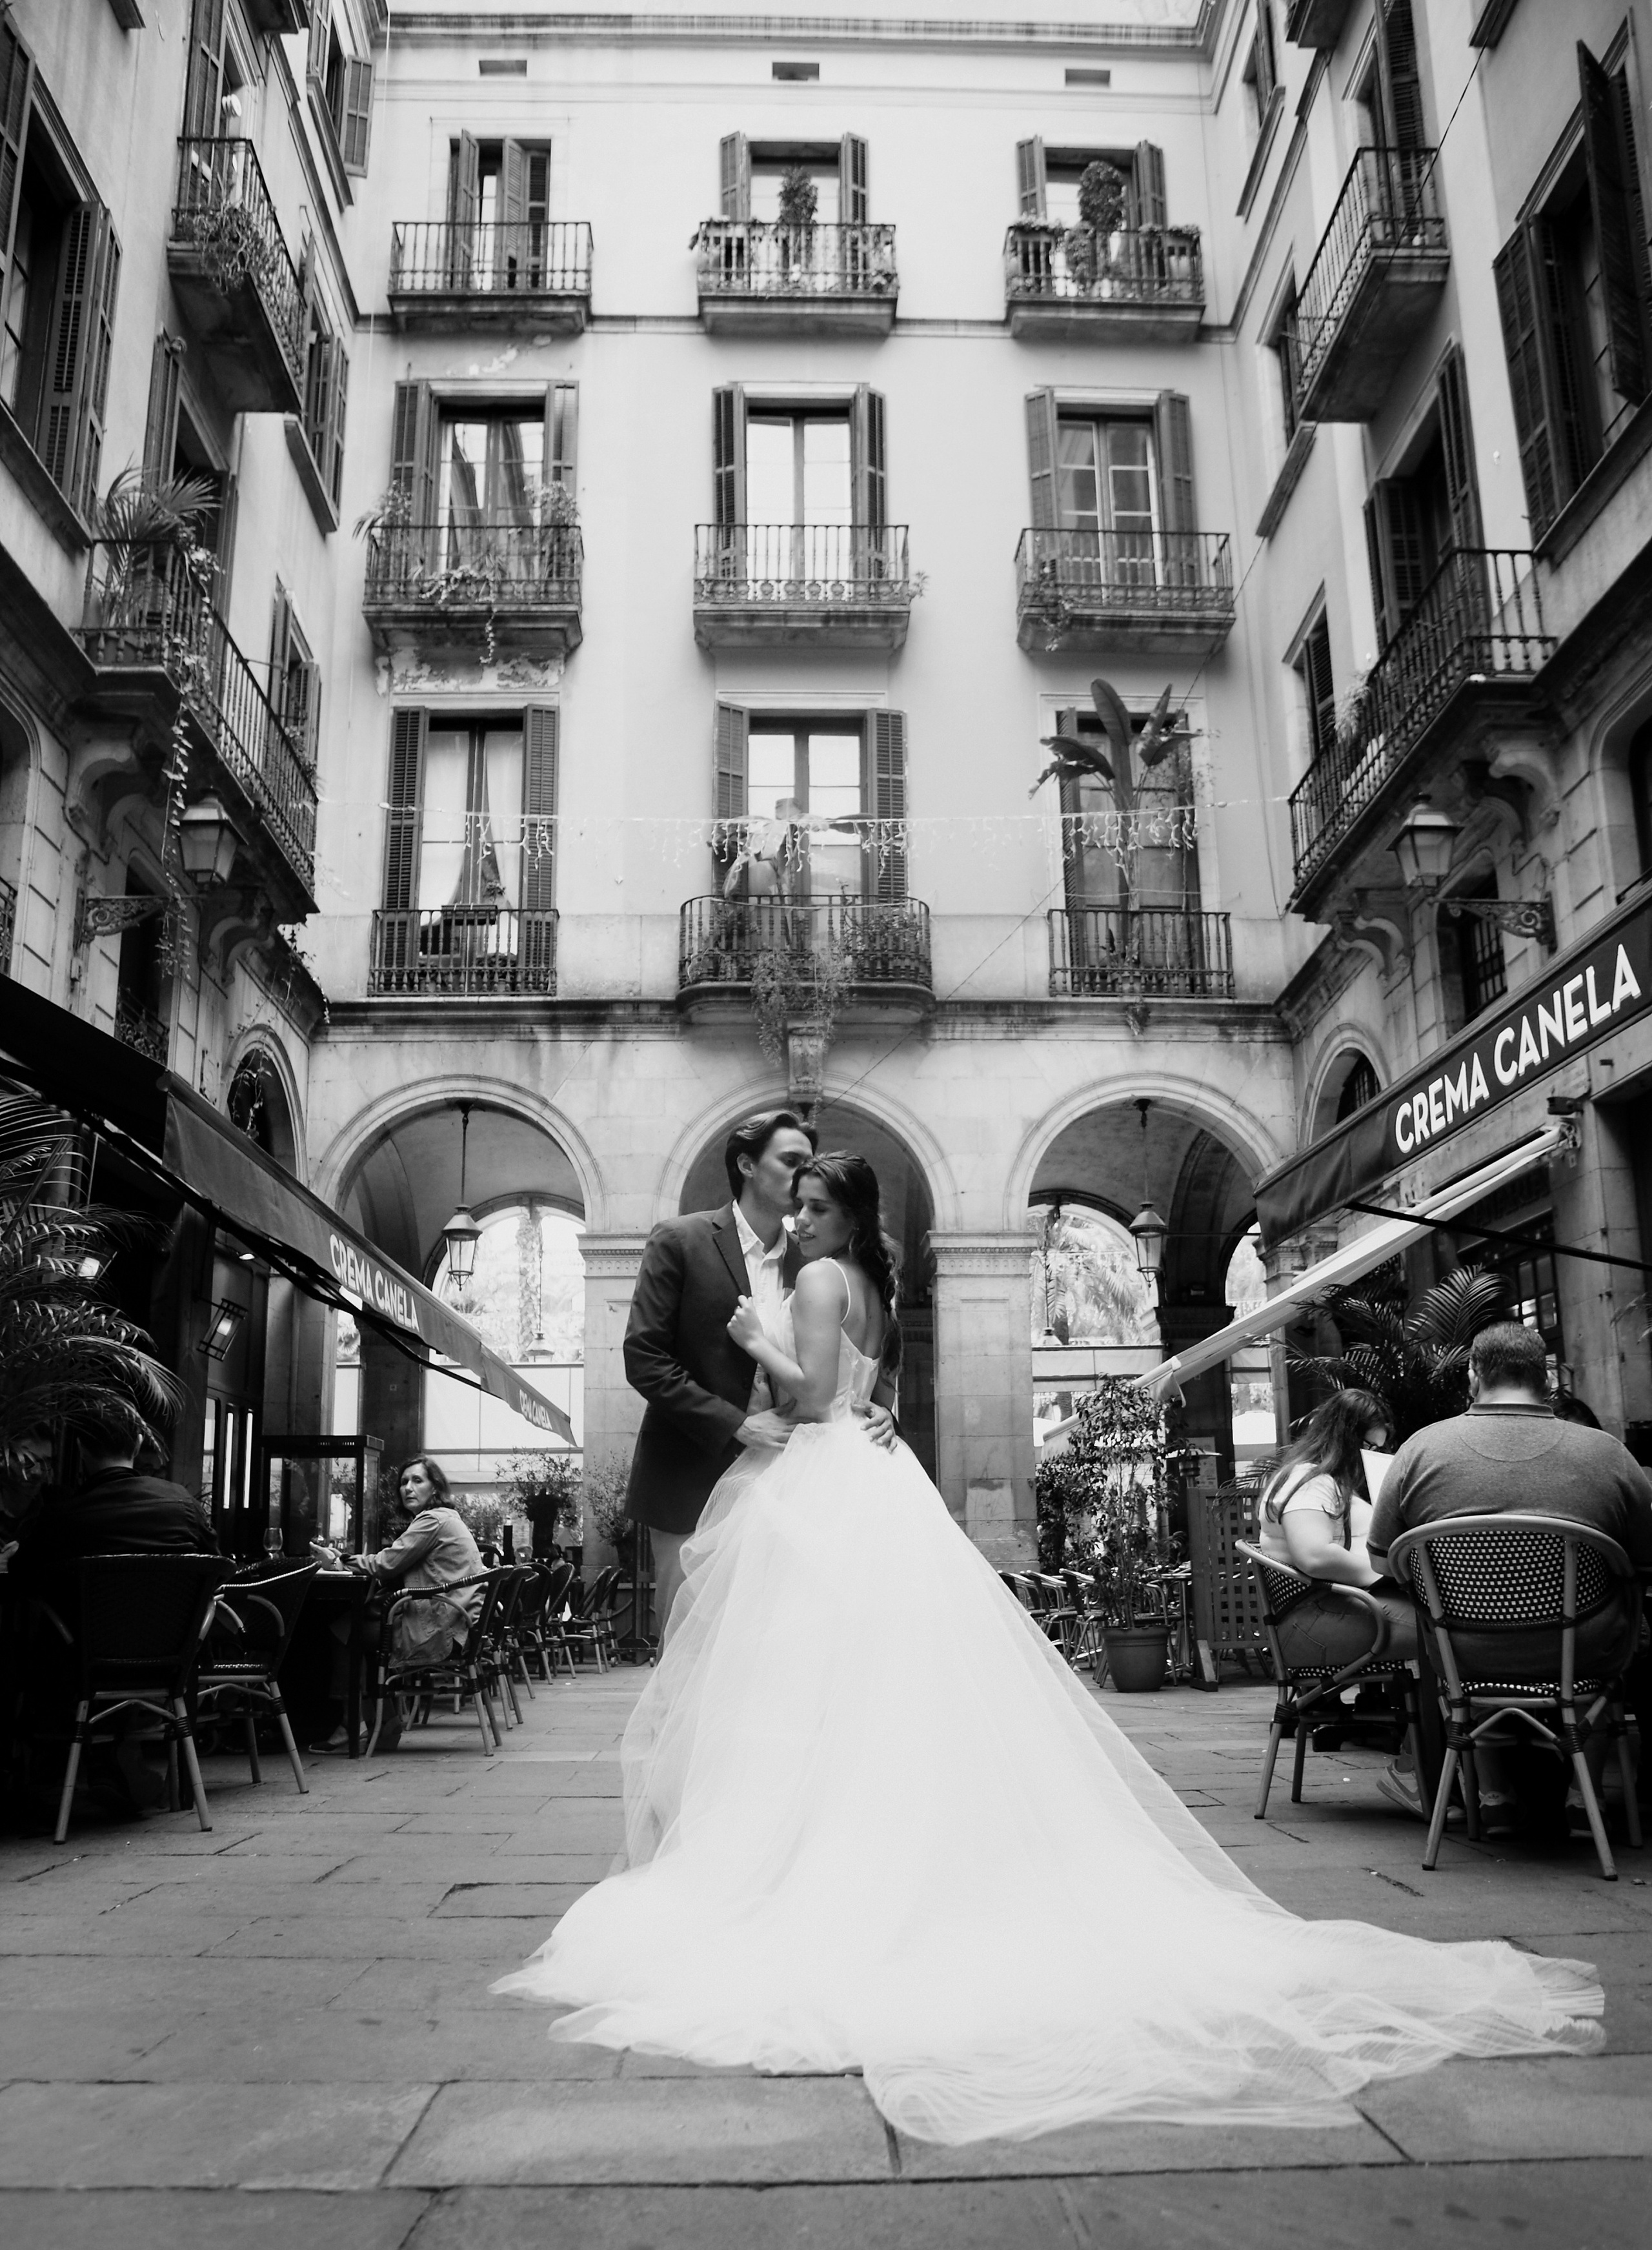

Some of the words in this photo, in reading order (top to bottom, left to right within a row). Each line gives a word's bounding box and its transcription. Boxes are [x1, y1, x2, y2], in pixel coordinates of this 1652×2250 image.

[1395, 1052, 1490, 1153] CREMA
[1494, 943, 1642, 1086] CANELA
[330, 1234, 374, 1304] CREMA
[375, 1270, 419, 1332] CANELA
